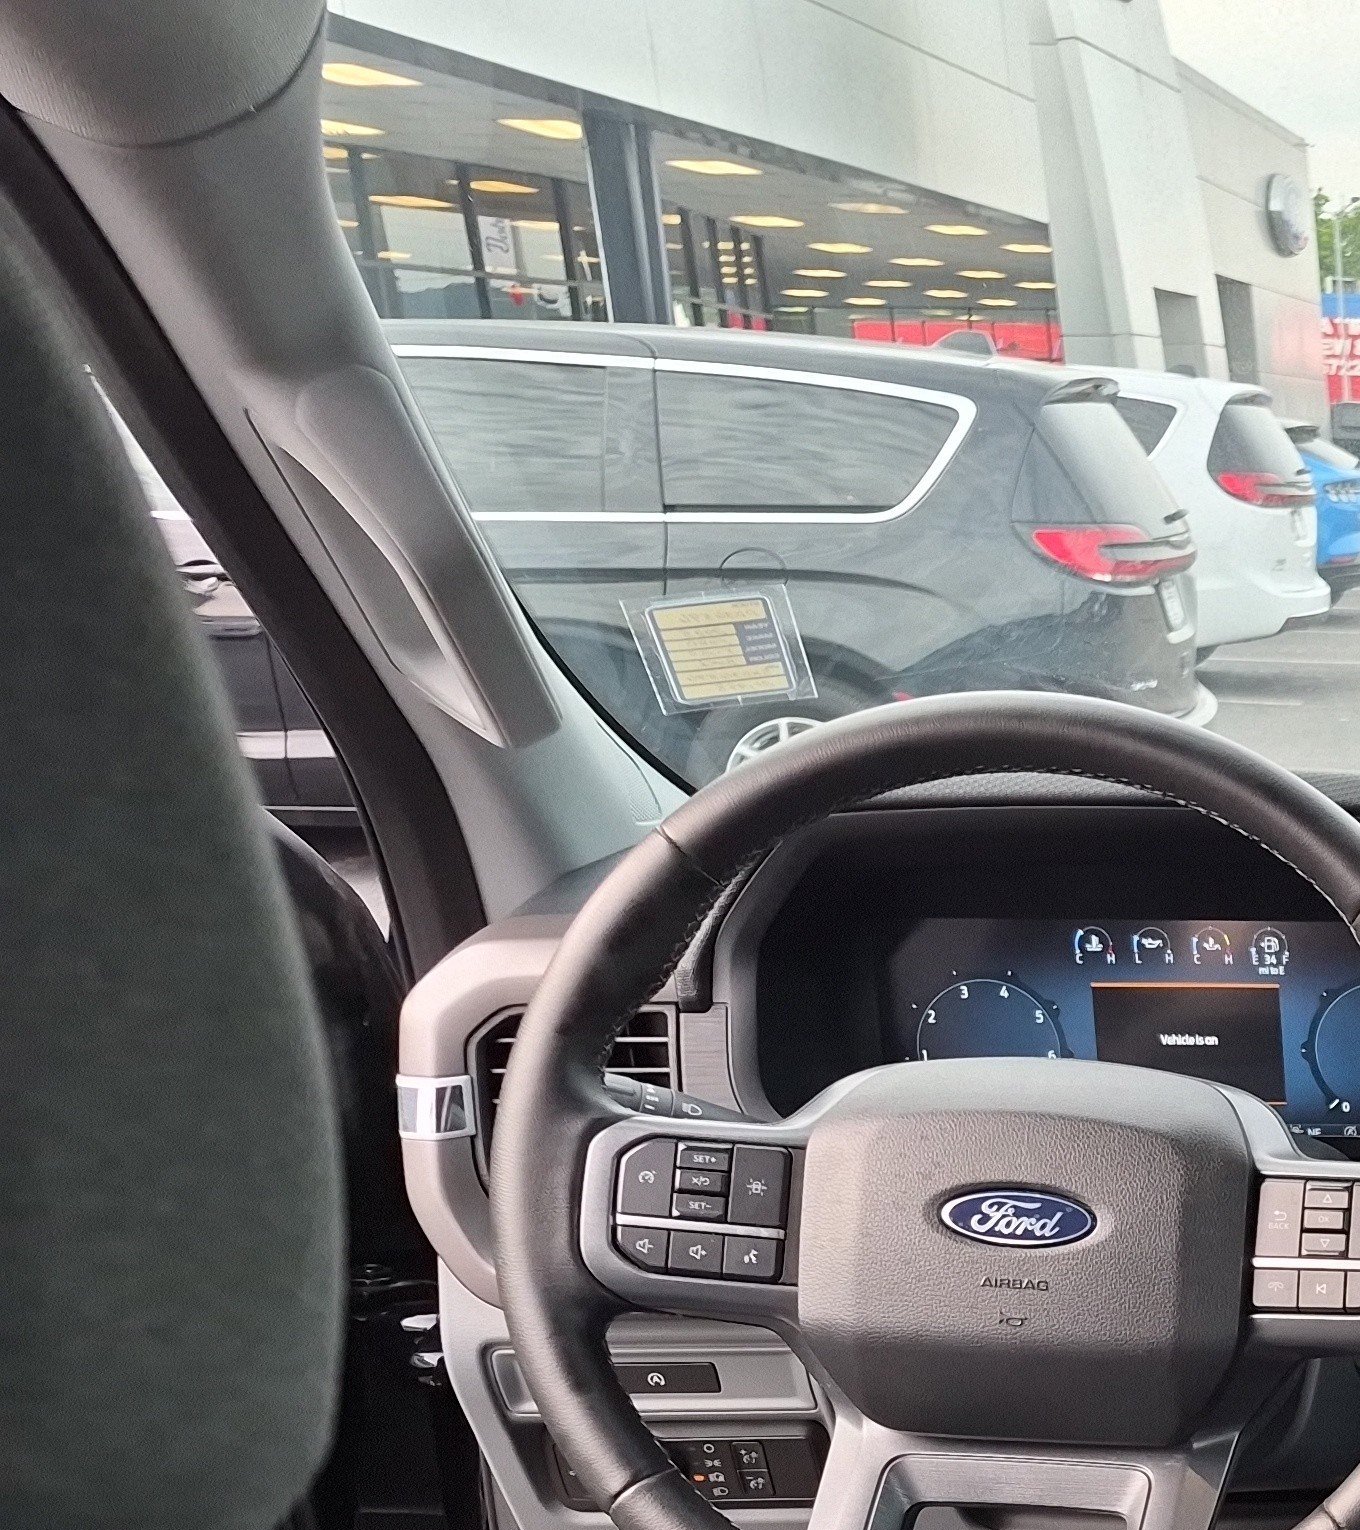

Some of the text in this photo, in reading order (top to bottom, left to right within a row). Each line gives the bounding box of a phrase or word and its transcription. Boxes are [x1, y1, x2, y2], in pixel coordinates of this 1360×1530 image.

[1264, 953, 1277, 965] 34
[959, 985, 969, 999] 3
[1000, 985, 1010, 999] 4
[927, 1010, 937, 1023] 2
[1035, 1010, 1045, 1023] 5
[1159, 1034, 1195, 1046] Vehicle
[970, 1198, 1064, 1237] Ford
[1268, 1222, 1290, 1231] BACK
[980, 1276, 1050, 1292] AIRBAG
